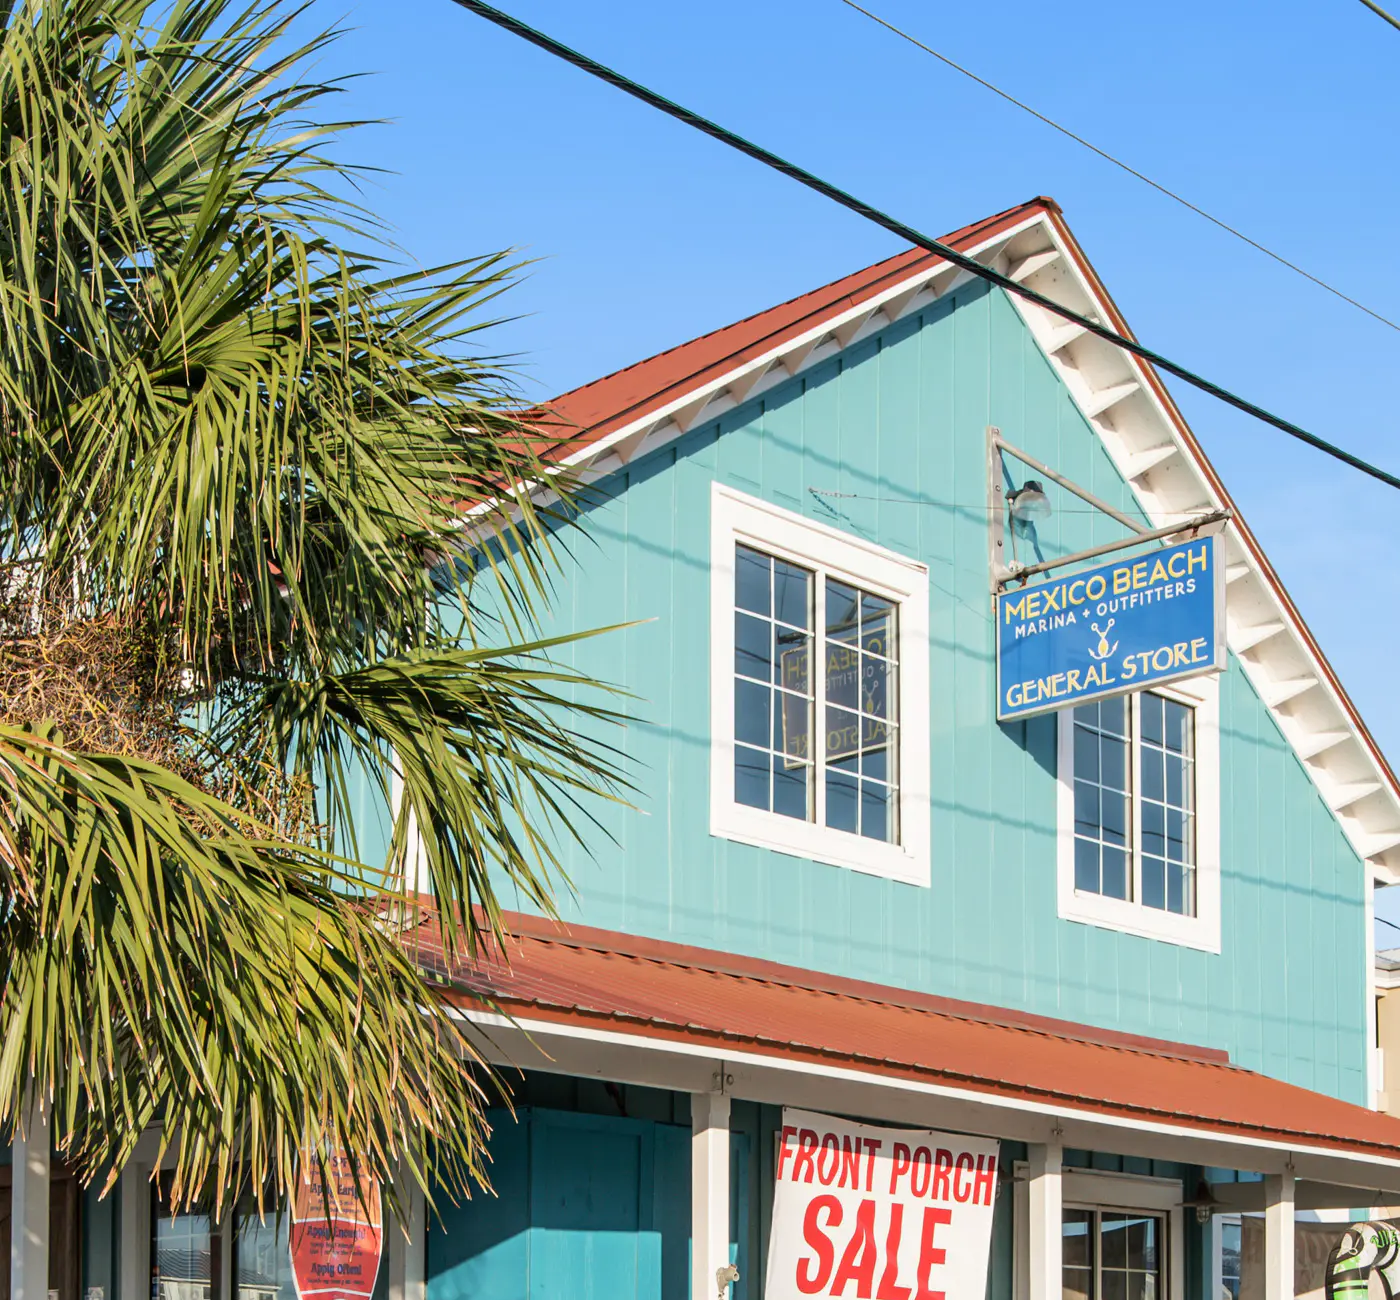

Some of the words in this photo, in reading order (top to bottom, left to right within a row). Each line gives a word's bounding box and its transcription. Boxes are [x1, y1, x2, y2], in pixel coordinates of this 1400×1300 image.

[1005, 575, 1107, 624] MEXICO
[1113, 545, 1207, 595] BEACH
[1015, 612, 1077, 639] MARINA
[1096, 579, 1196, 616] OUTFITTERS
[1006, 662, 1115, 707] GENERAL
[1120, 637, 1209, 680] STORE
[777, 1126, 882, 1192] FRONT
[889, 1142, 996, 1206] PORCH
[311, 1263, 335, 1278] Apply
